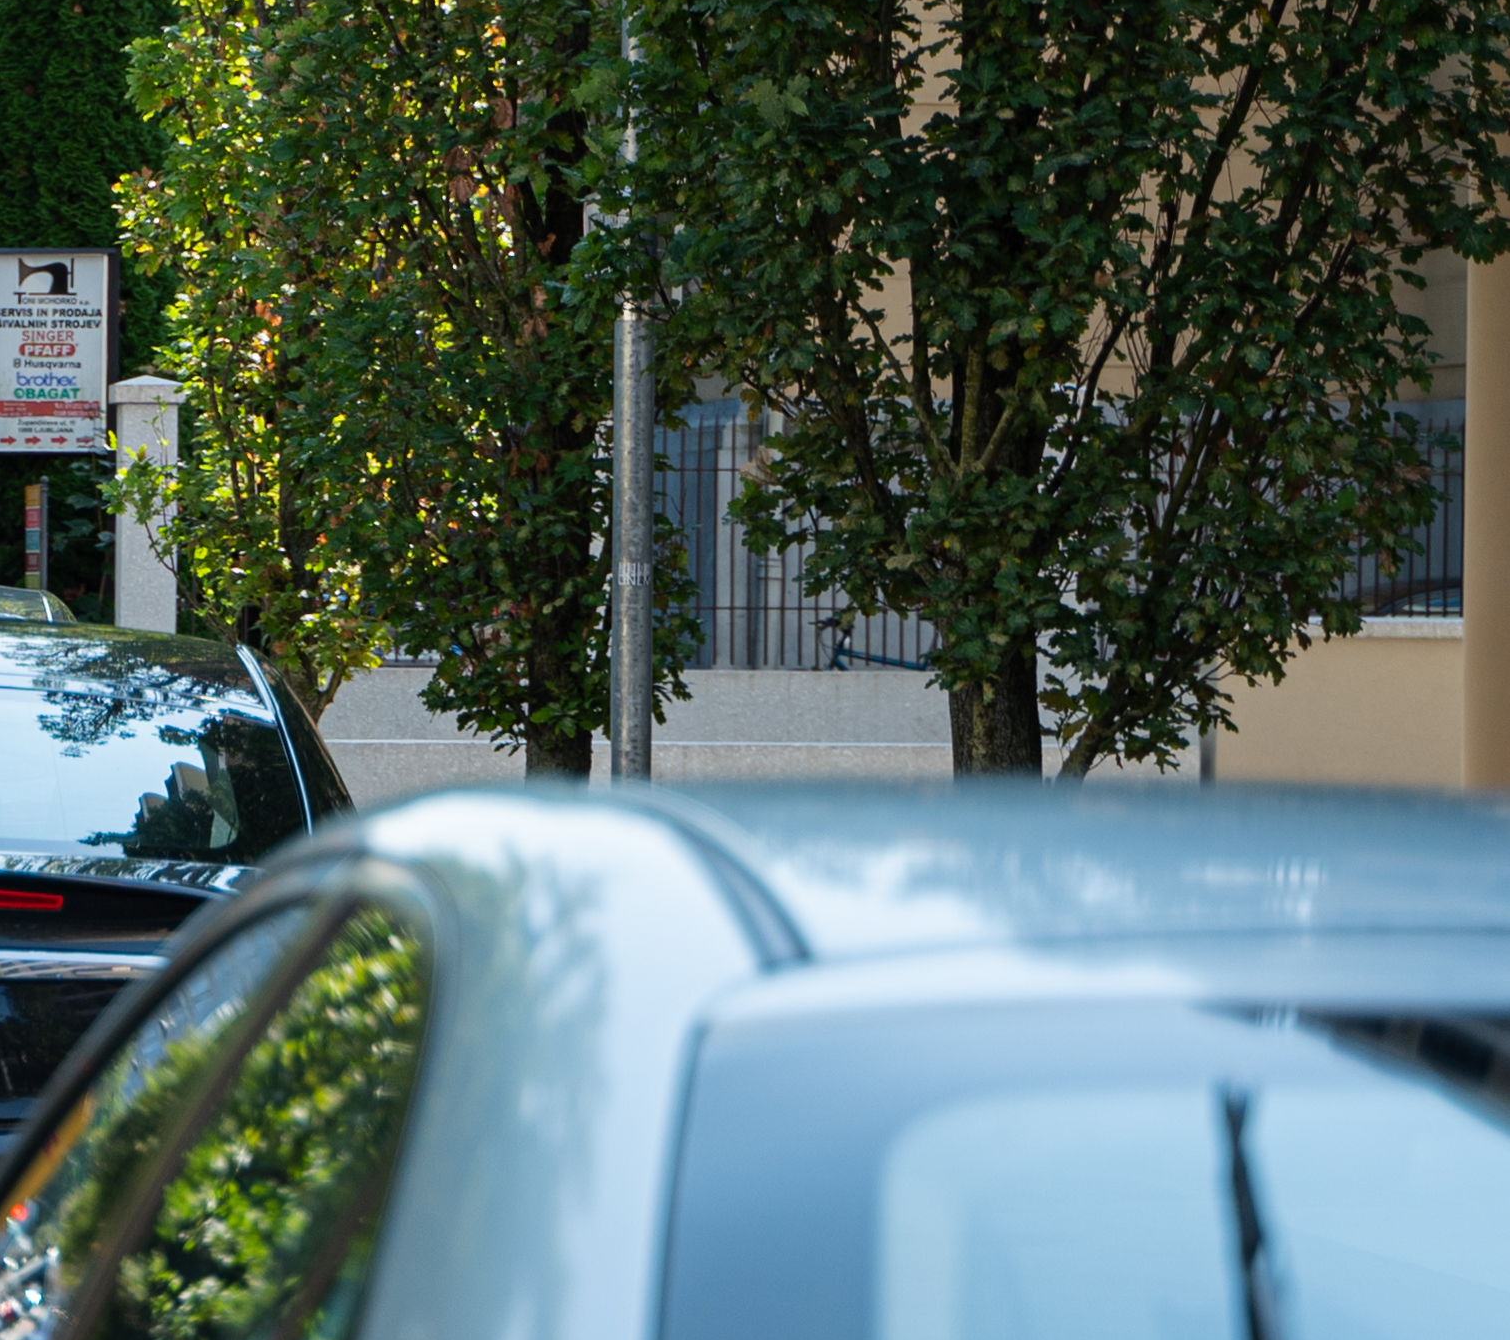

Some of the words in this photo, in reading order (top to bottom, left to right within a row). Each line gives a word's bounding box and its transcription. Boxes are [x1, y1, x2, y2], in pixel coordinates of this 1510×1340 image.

[37, 308, 48, 317] IN
[52, 308, 103, 317] PRODAJA
[51, 320, 102, 329] STROJEV
[22, 330, 75, 342] SINGER
[24, 345, 72, 356] PFAFF
[24, 359, 82, 369] Husqvarna
